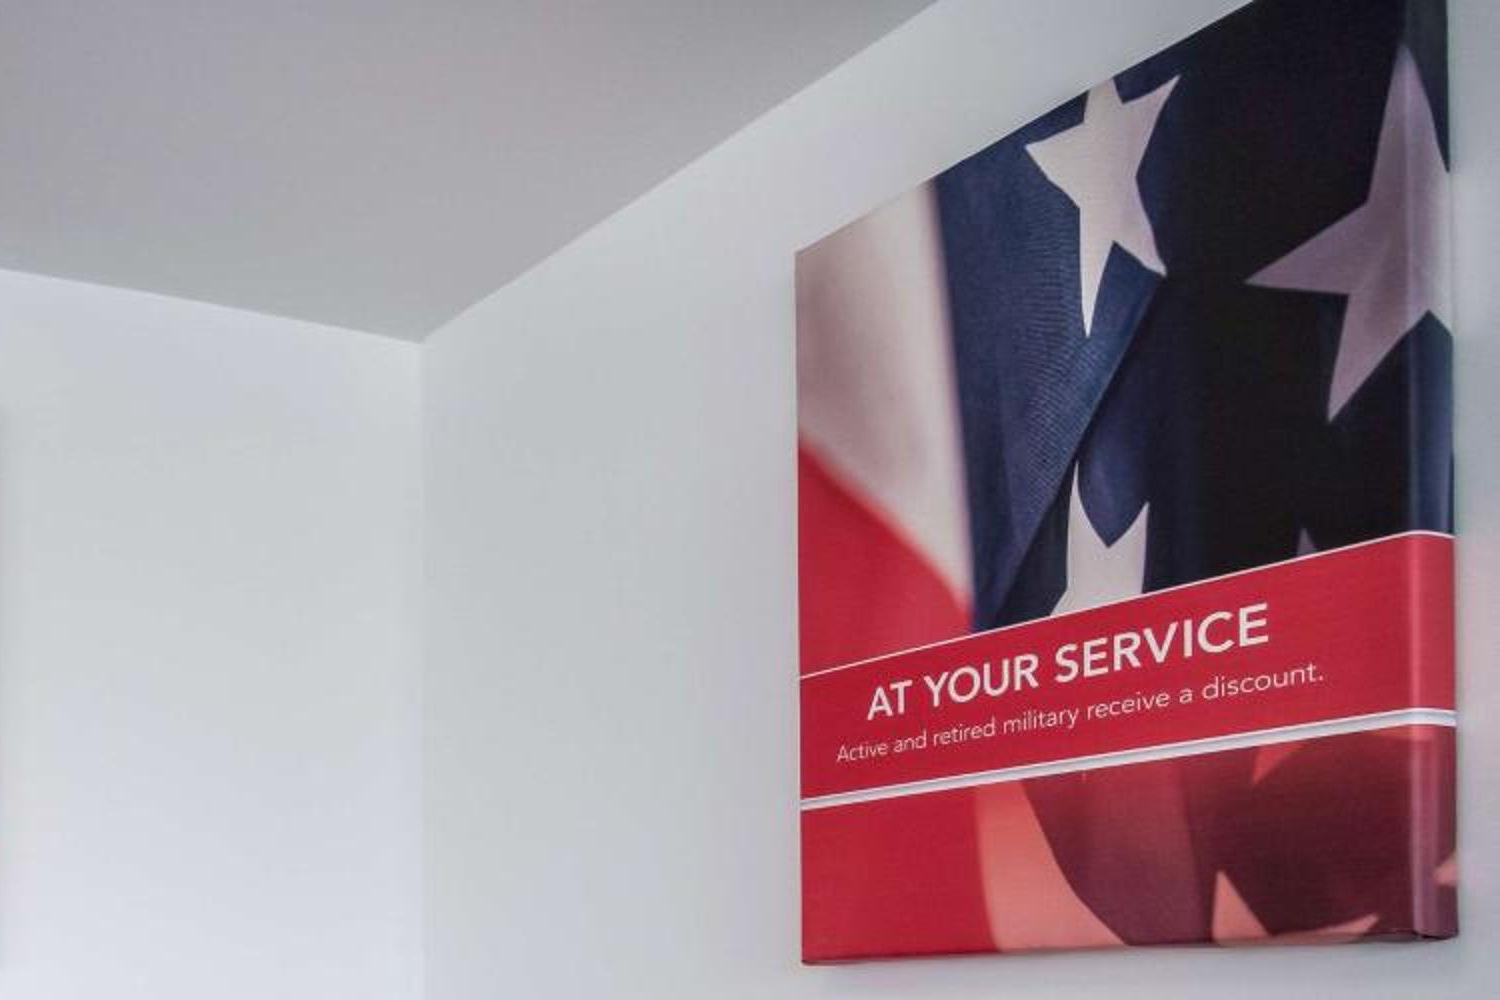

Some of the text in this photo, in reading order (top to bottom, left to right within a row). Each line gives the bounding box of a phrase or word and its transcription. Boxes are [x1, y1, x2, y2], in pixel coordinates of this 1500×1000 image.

[836, 662, 1324, 762] Active and retired military receive a discount.
[867, 602, 1269, 720] AT YOUR SERVICE
